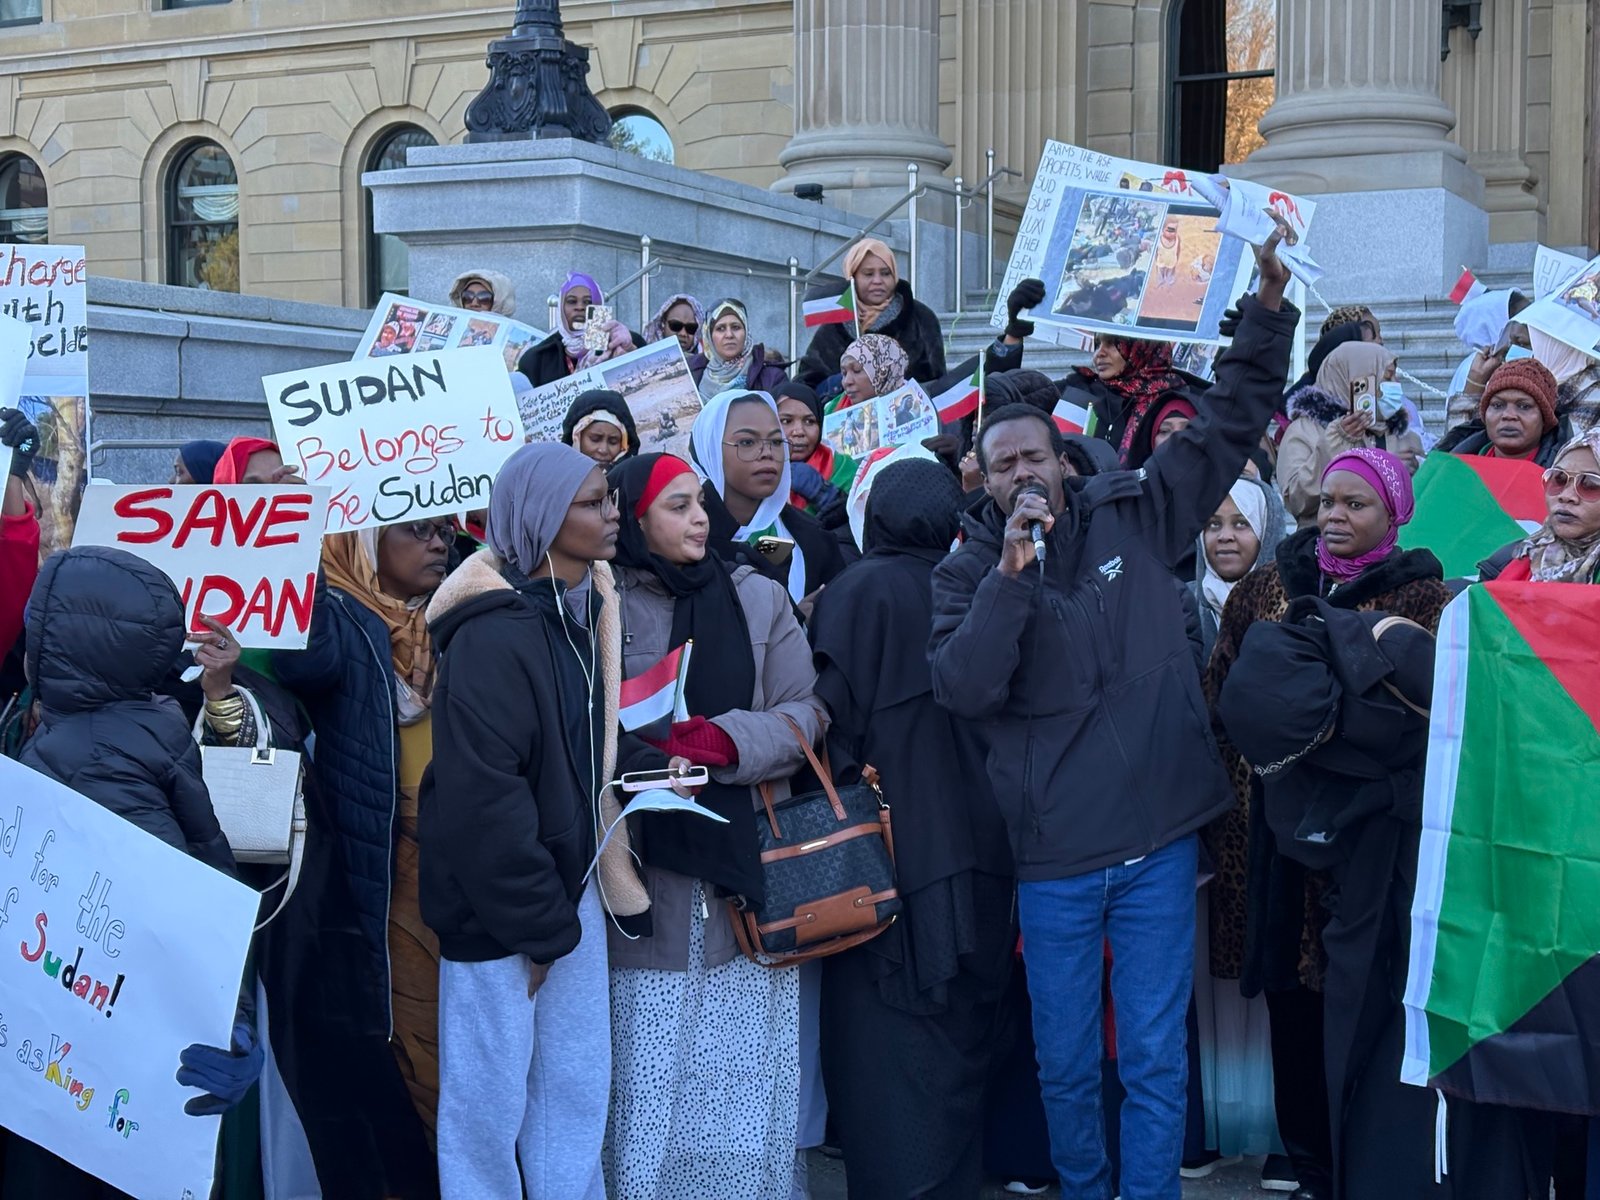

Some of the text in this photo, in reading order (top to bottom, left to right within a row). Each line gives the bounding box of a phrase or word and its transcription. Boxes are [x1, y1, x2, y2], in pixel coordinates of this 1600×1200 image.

[1047, 142, 1075, 157] ARMS
[1079, 149, 1095, 163] THE
[279, 358, 448, 426] SUDAN
[296, 405, 514, 481] Belongs to
[114, 488, 313, 549] SAVE
[181, 572, 315, 637] DAN
[31, 829, 59, 893] for
[76, 871, 125, 958] the
[20, 910, 125, 1018] Sudan!
[108, 1088, 139, 1139] for
